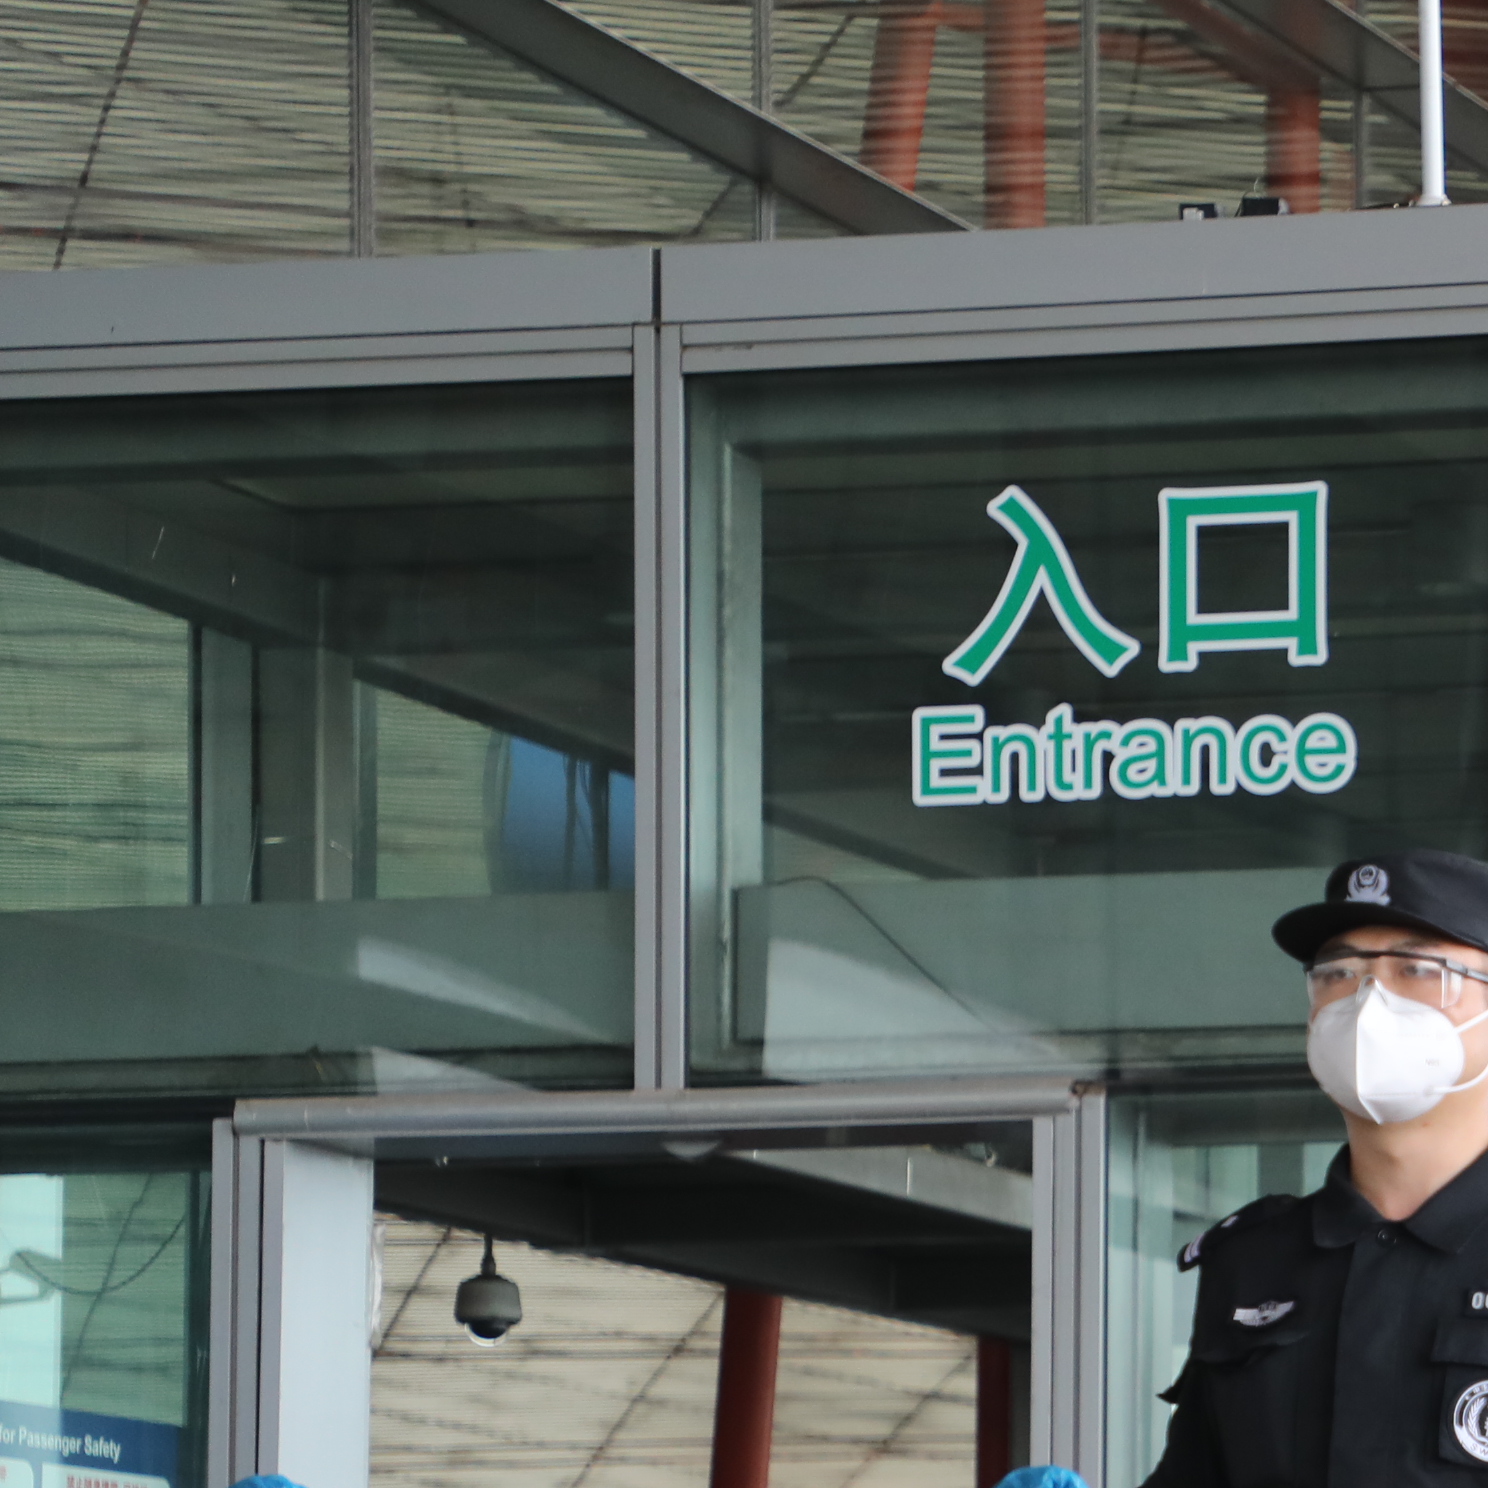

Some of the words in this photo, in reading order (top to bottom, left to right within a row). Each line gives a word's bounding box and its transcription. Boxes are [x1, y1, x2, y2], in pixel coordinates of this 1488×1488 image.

[942, 482, 1329, 687] 入口
[912, 702, 1358, 807] Entrance
[19, 1424, 83, 1457] Passenger
[84, 1433, 121, 1463] Safety
